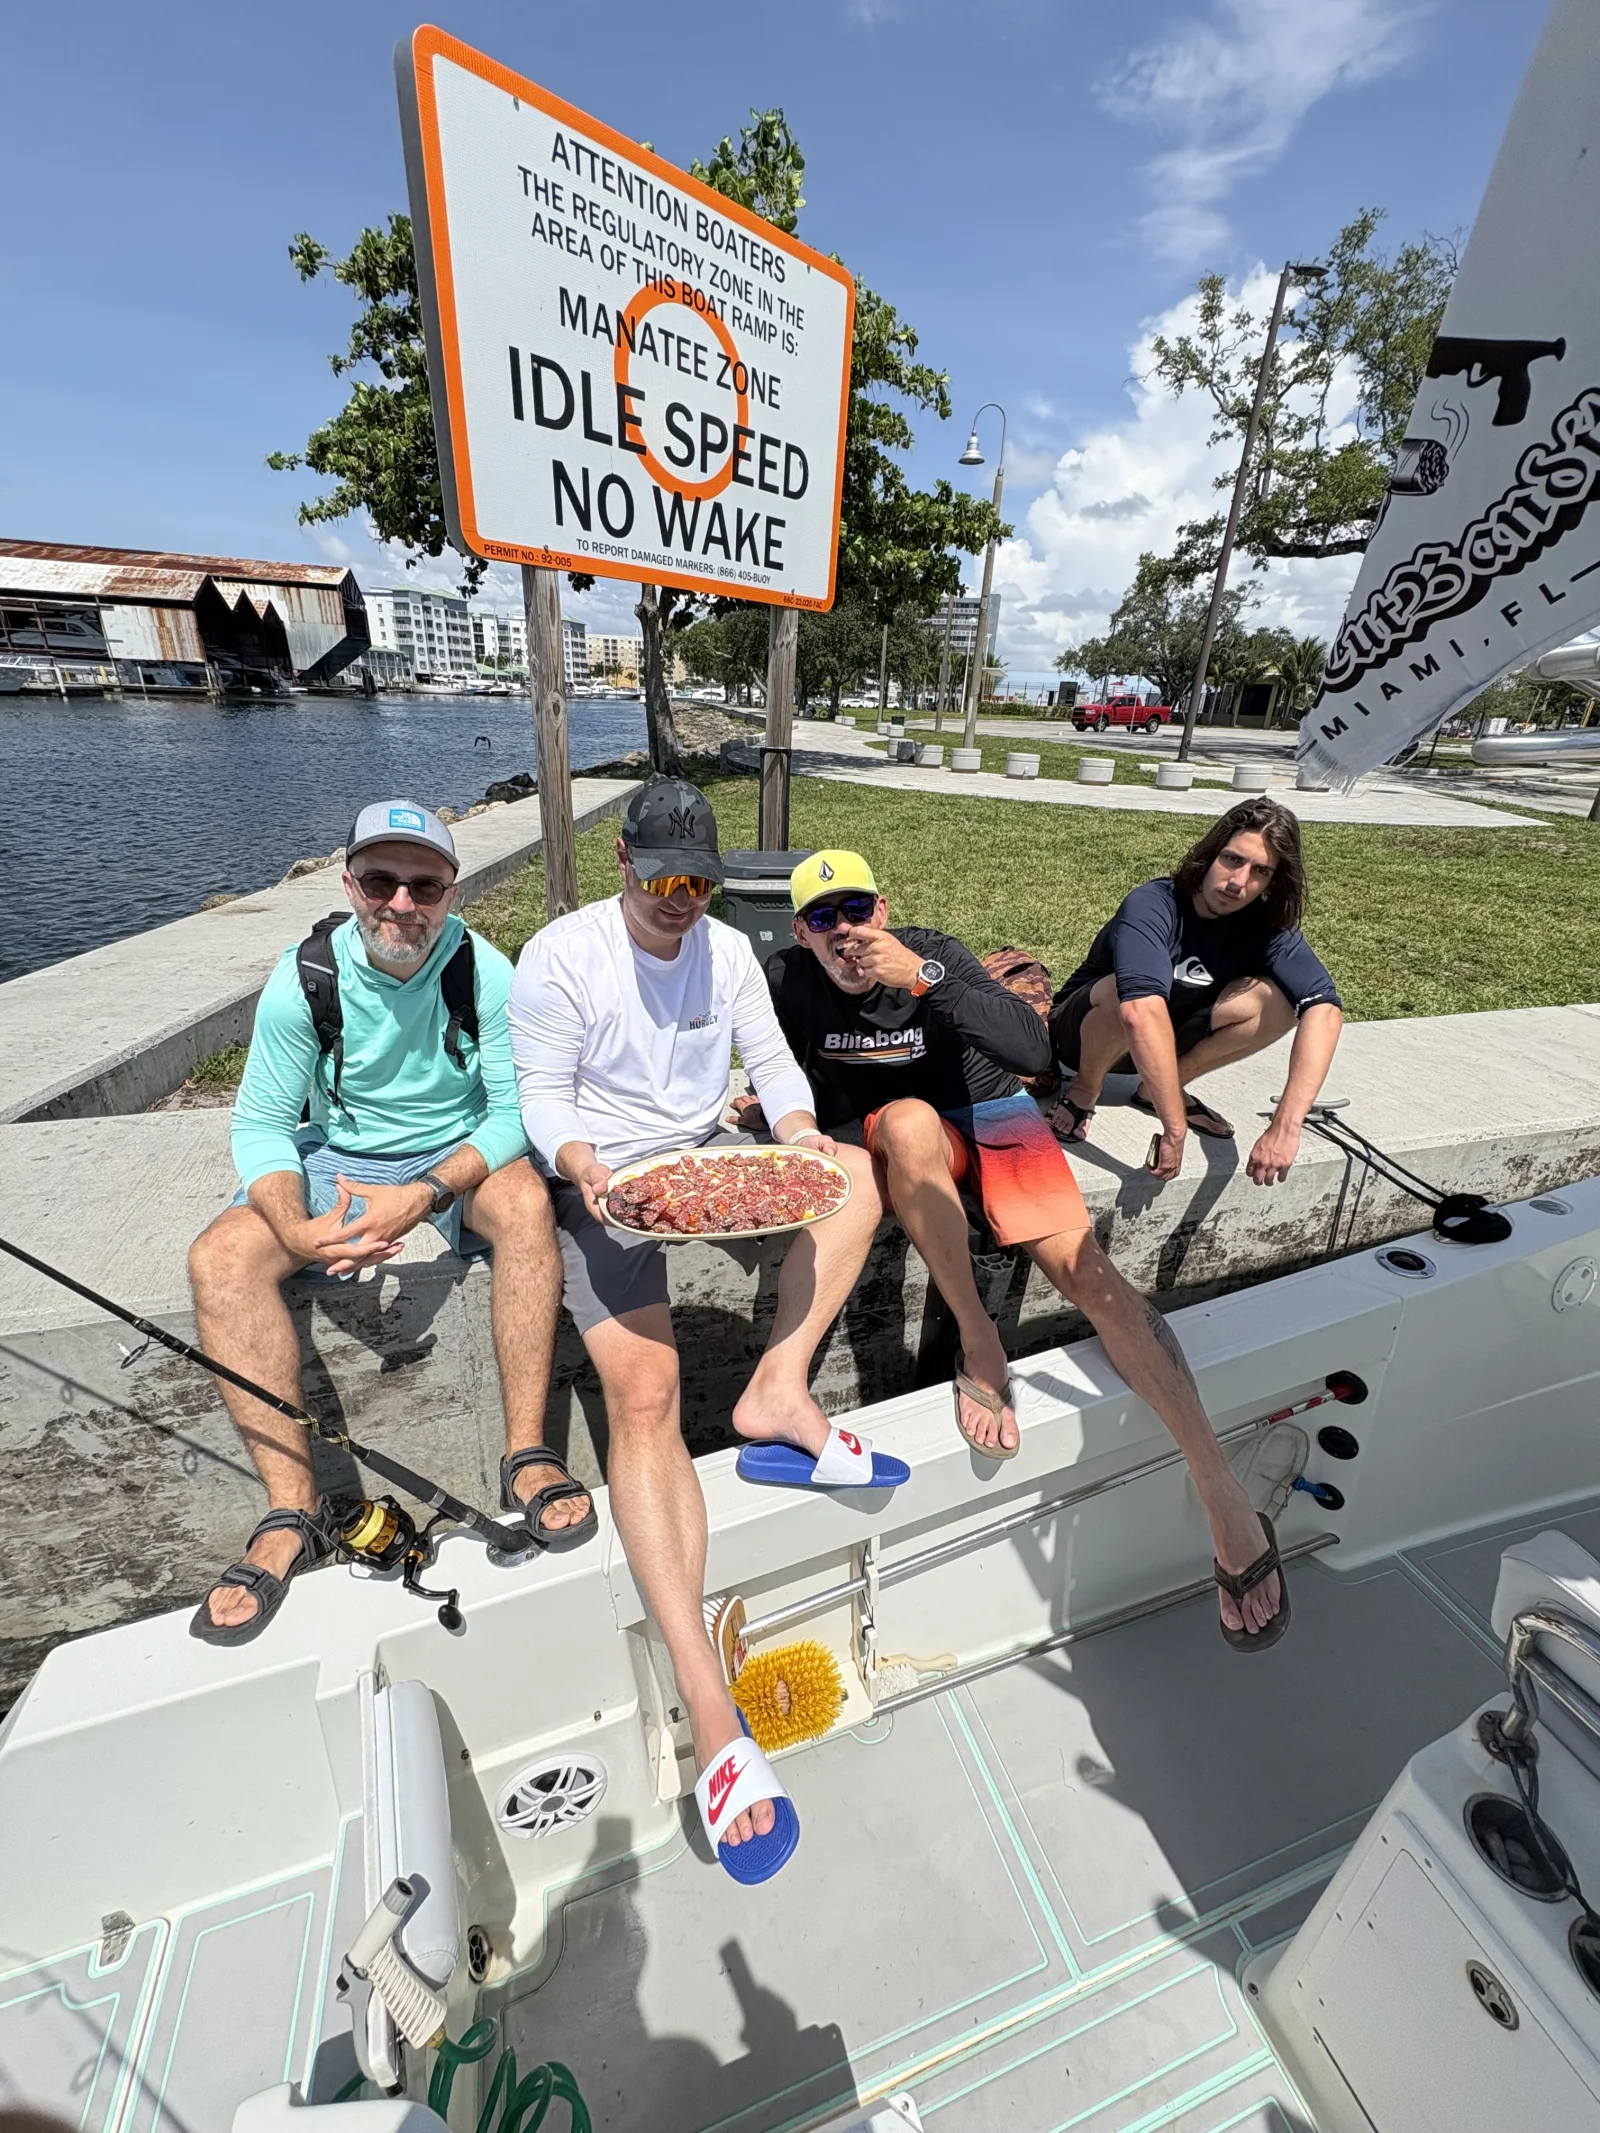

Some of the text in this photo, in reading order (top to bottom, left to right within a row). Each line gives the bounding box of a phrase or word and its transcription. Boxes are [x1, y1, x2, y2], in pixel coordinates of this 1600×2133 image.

[517, 164, 805, 331] THE REGULATORY ZONE IN THE
[551, 131, 786, 283] ATTENTION BOATERS
[531, 212, 799, 356] AREA OF THIS BOAT RAMP IS:
[558, 286, 781, 410] MANATEE ZONE
[509, 345, 809, 500] IDLE SPEED
[483, 543, 519, 559] PERMIT
[541, 553, 573, 568] 92-005
[552, 459, 786, 571] NO WAKE
[576, 538, 771, 585] TO REPORT DAMAGED MARKERS: (866) 405-BUOY
[1319, 582, 1567, 742] MIAMI, FL
[824, 1026, 924, 1049] Billabong
[708, 1754, 737, 1804] NIKE
